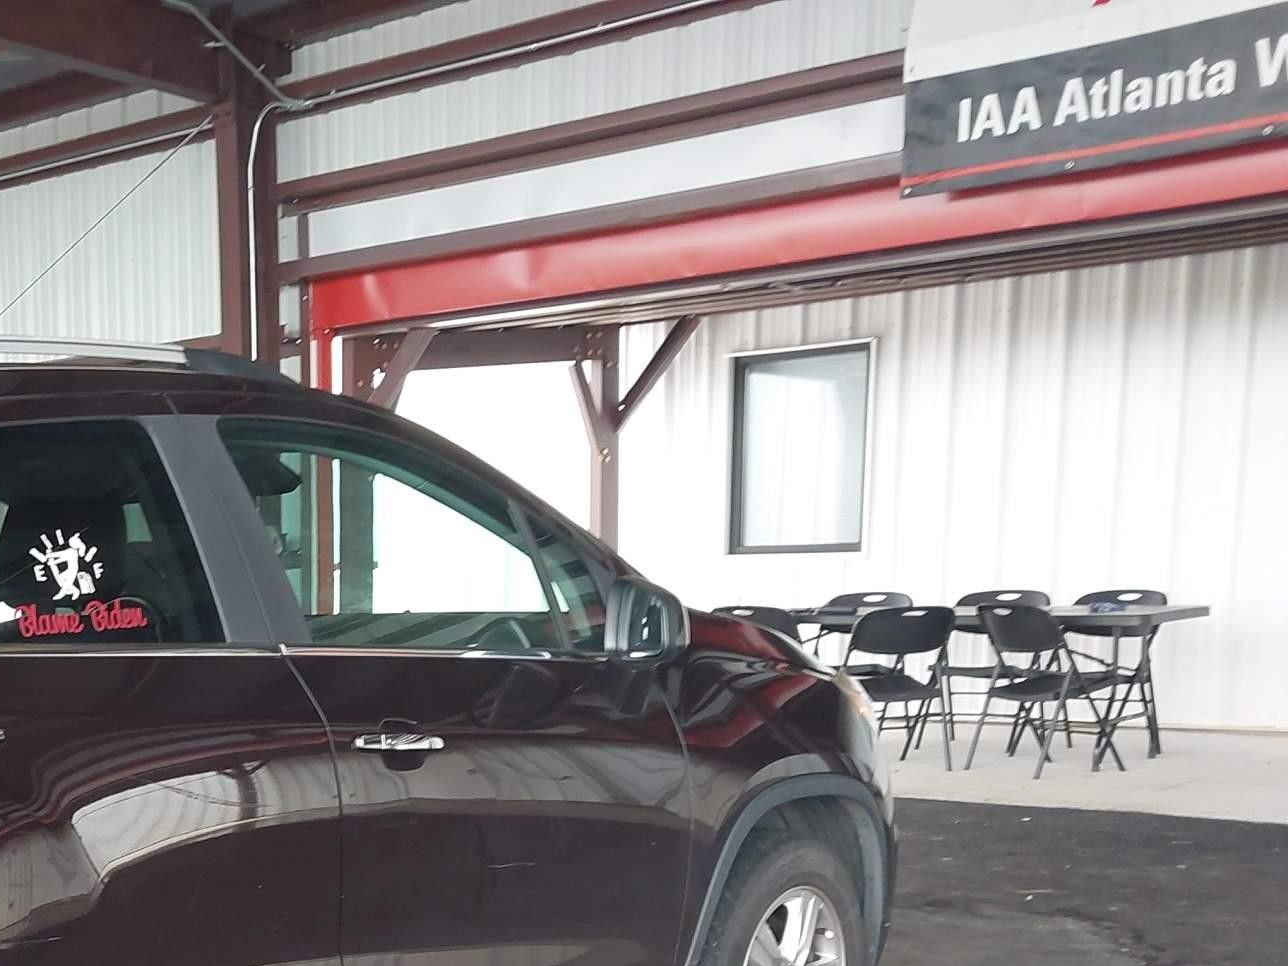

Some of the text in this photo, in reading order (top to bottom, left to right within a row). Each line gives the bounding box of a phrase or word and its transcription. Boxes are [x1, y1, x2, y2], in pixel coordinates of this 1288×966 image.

[957, 86, 1043, 143] IAA
[1053, 56, 1238, 127] Atlanta
[33, 562, 104, 581] E F
[16, 600, 148, 637] Blame Biden
